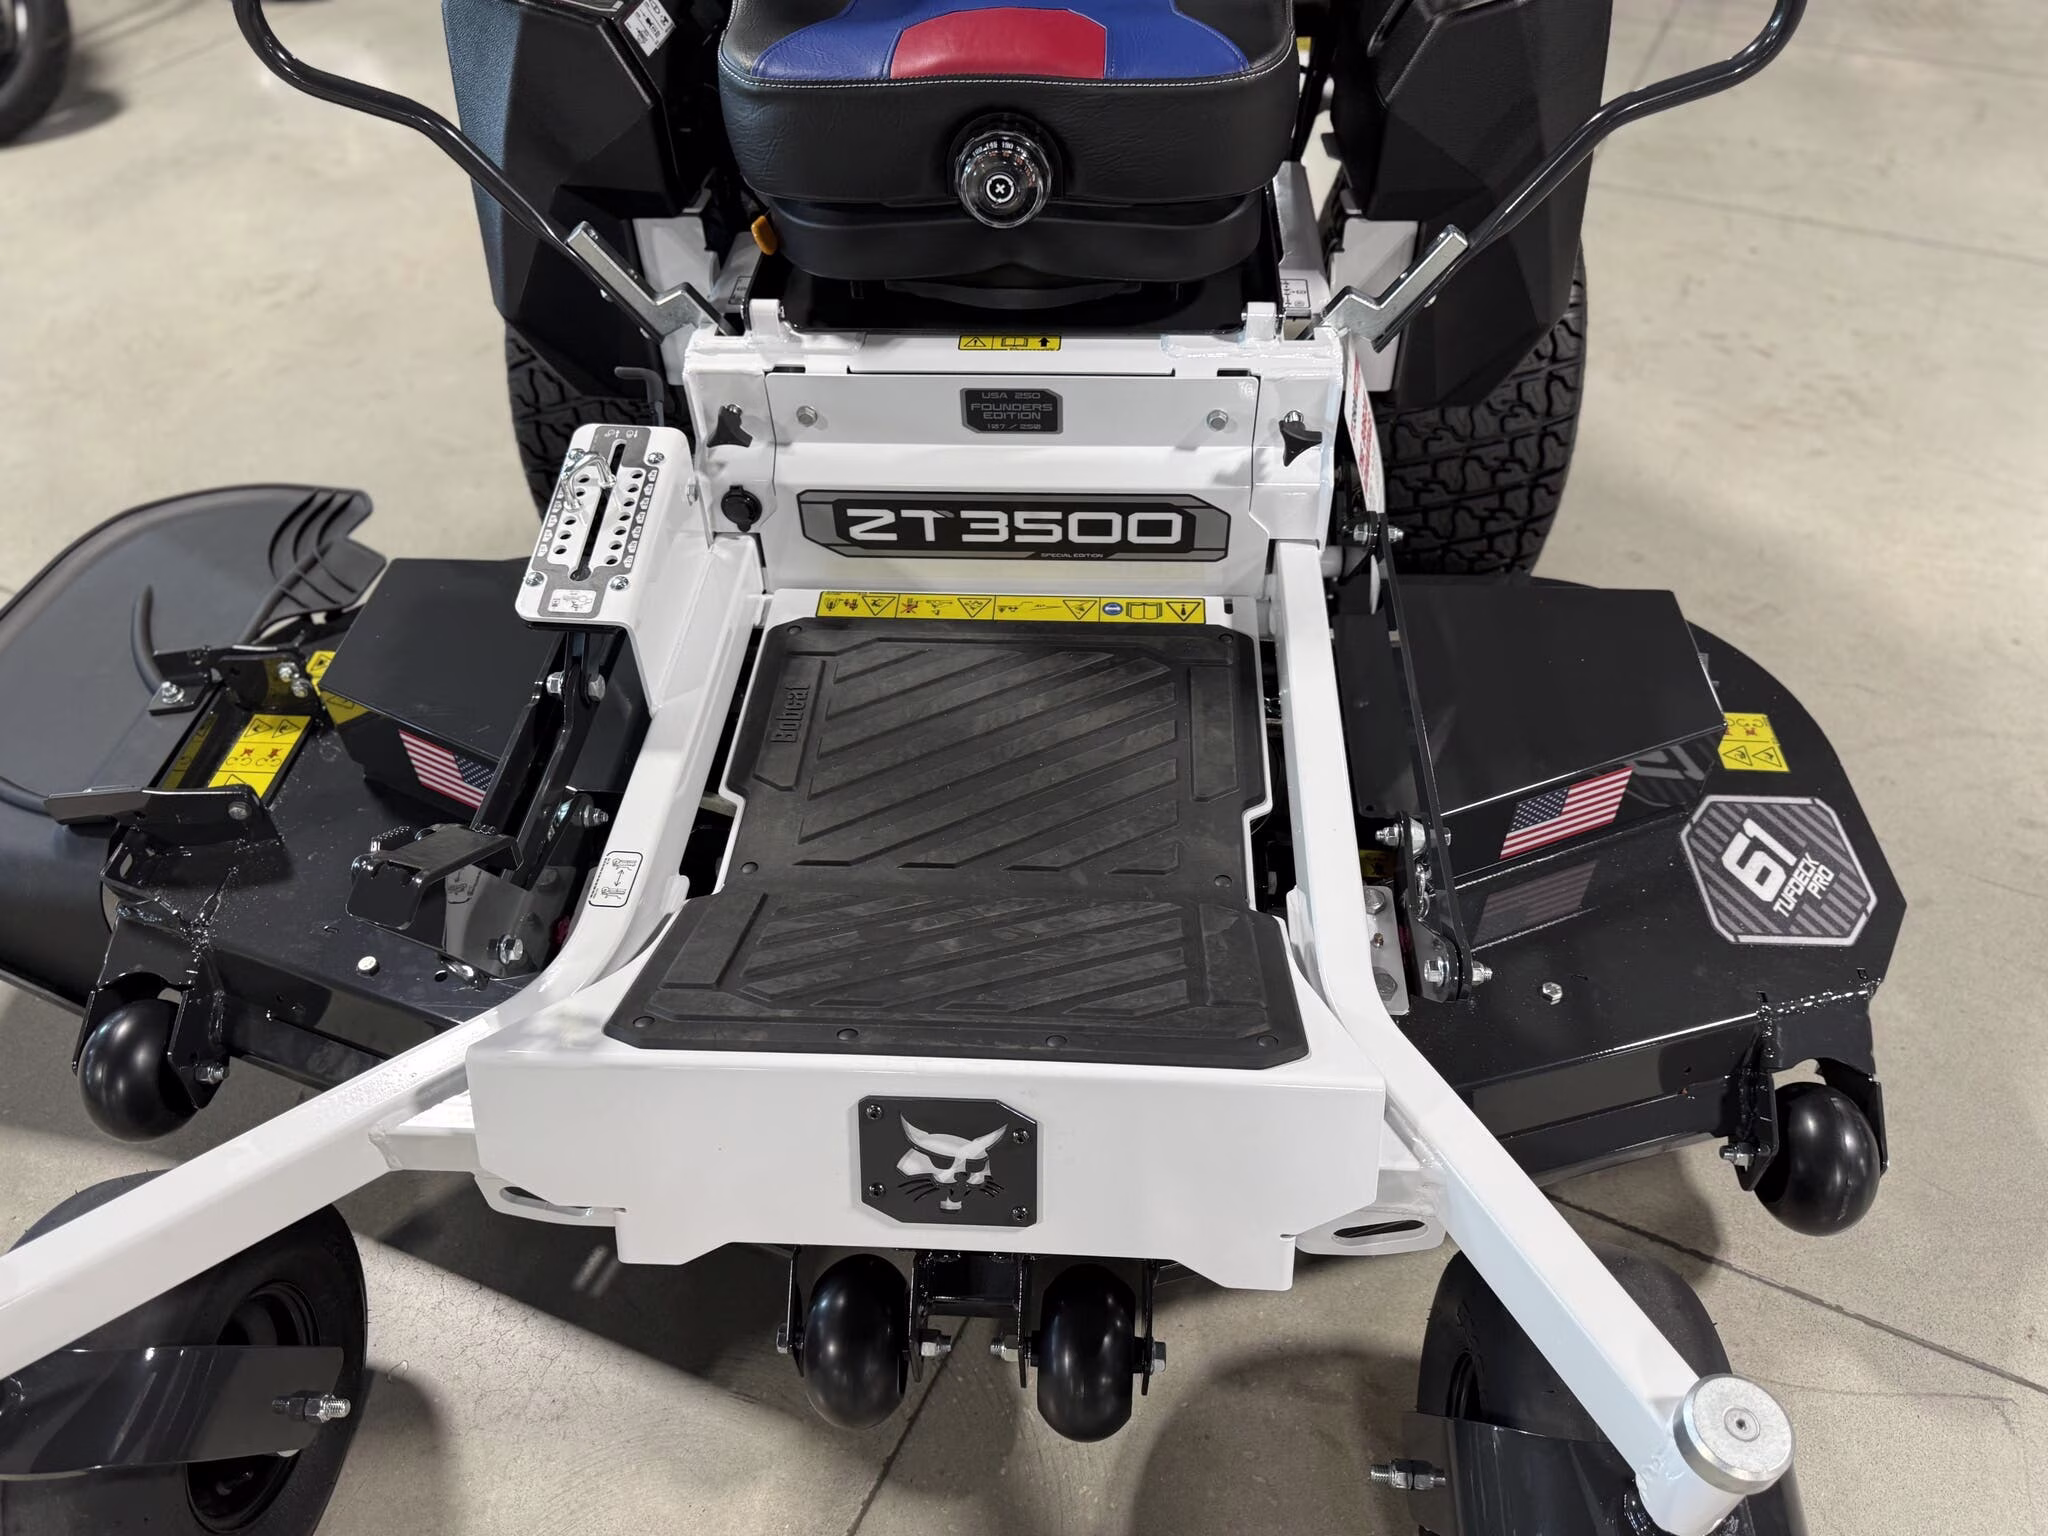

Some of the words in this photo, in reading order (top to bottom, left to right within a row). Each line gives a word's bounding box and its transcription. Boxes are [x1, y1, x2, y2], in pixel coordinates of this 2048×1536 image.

[970, 403, 1053, 411] FOUNDERS
[983, 412, 1041, 420] EDITION
[846, 508, 1183, 545] ZT3500
[769, 685, 811, 744] Bobcat
[1721, 818, 1798, 902] 61
[1772, 852, 1820, 918] TUFDECK
[1807, 864, 1835, 900] PRO
